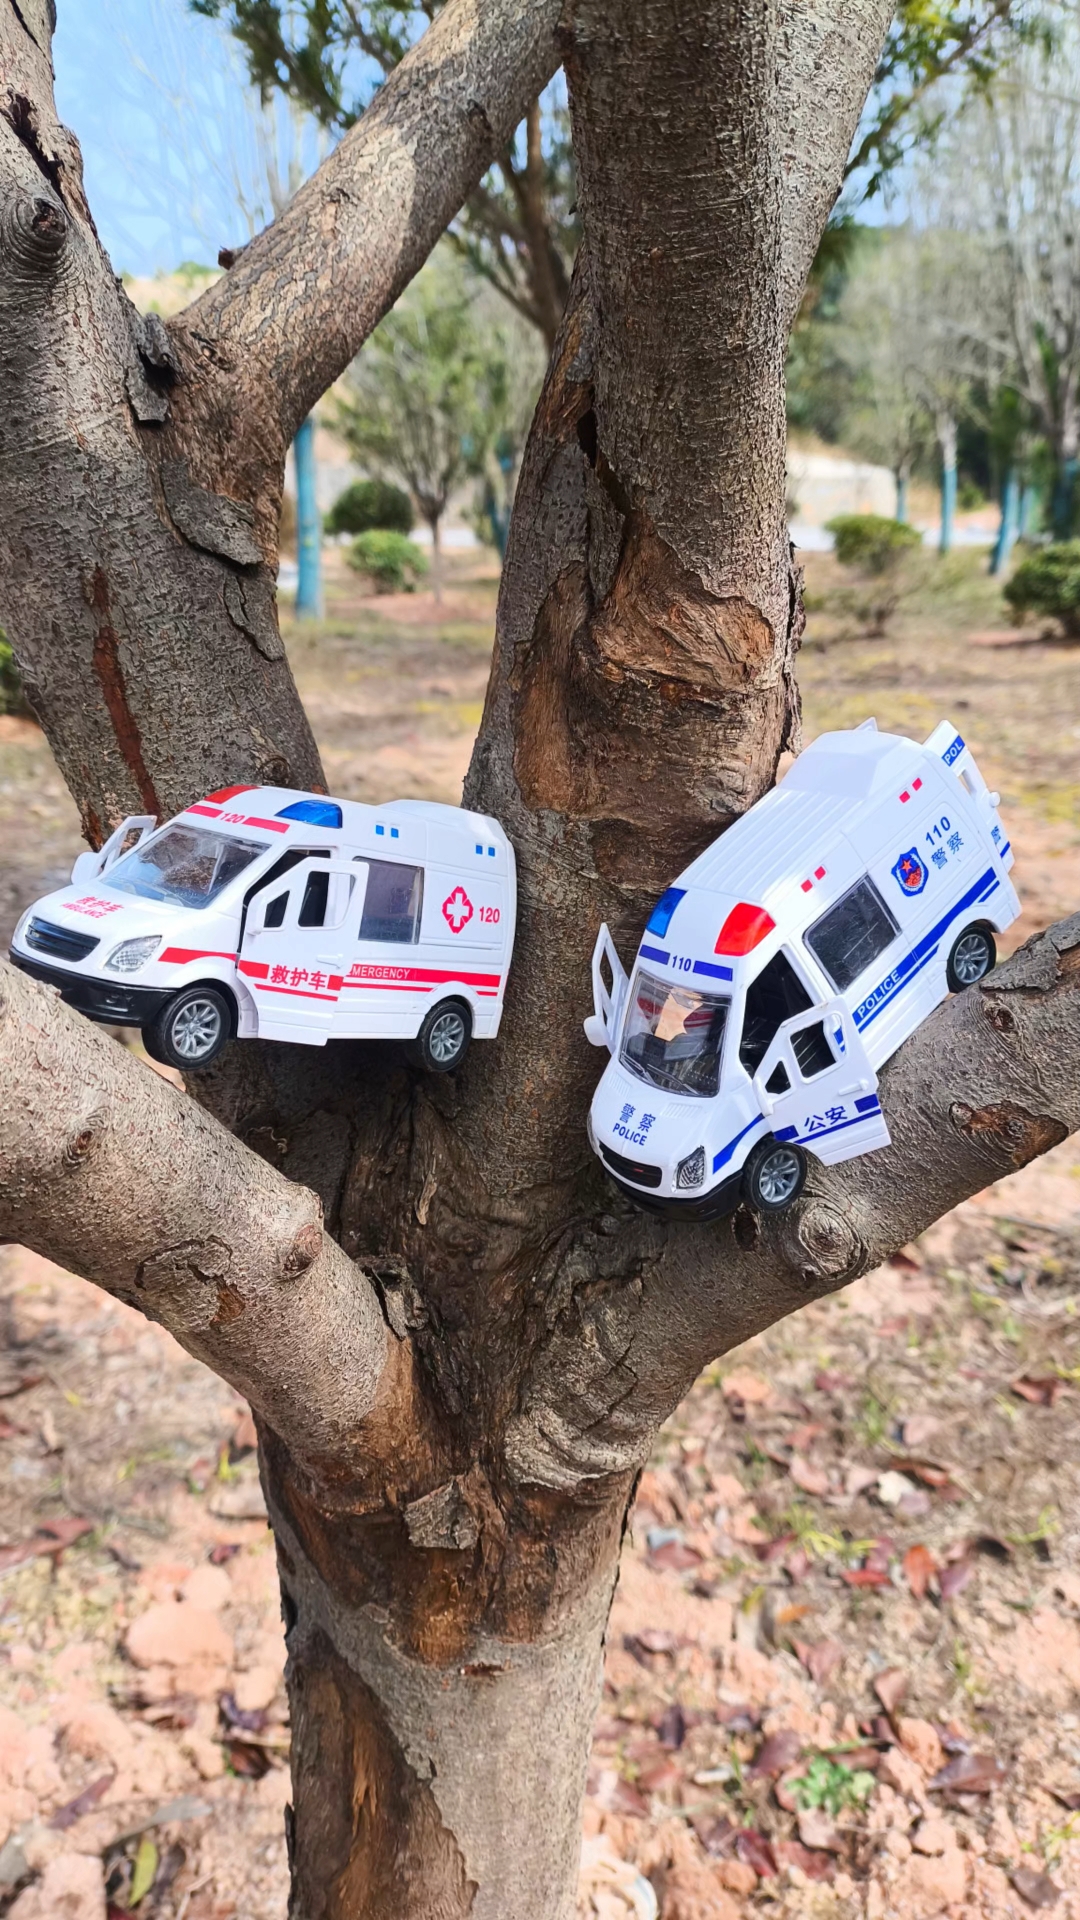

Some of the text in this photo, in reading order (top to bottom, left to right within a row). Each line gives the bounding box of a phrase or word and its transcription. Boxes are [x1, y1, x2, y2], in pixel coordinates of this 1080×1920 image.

[220, 812, 245, 824] 120
[925, 816, 951, 846] 110
[931, 831, 964, 870] 警察
[61, 903, 107, 919] AMBULANCE
[75, 896, 124, 912] 救护车
[479, 906, 500, 924] 120
[350, 965, 411, 980] MERGENCY
[672, 955, 692, 972] 110
[270, 964, 328, 991] 救护车
[857, 969, 901, 1018] POLICE
[619, 1103, 657, 1133] 警察
[804, 1105, 848, 1132] 公安
[612, 1122, 648, 1146] POLICE
